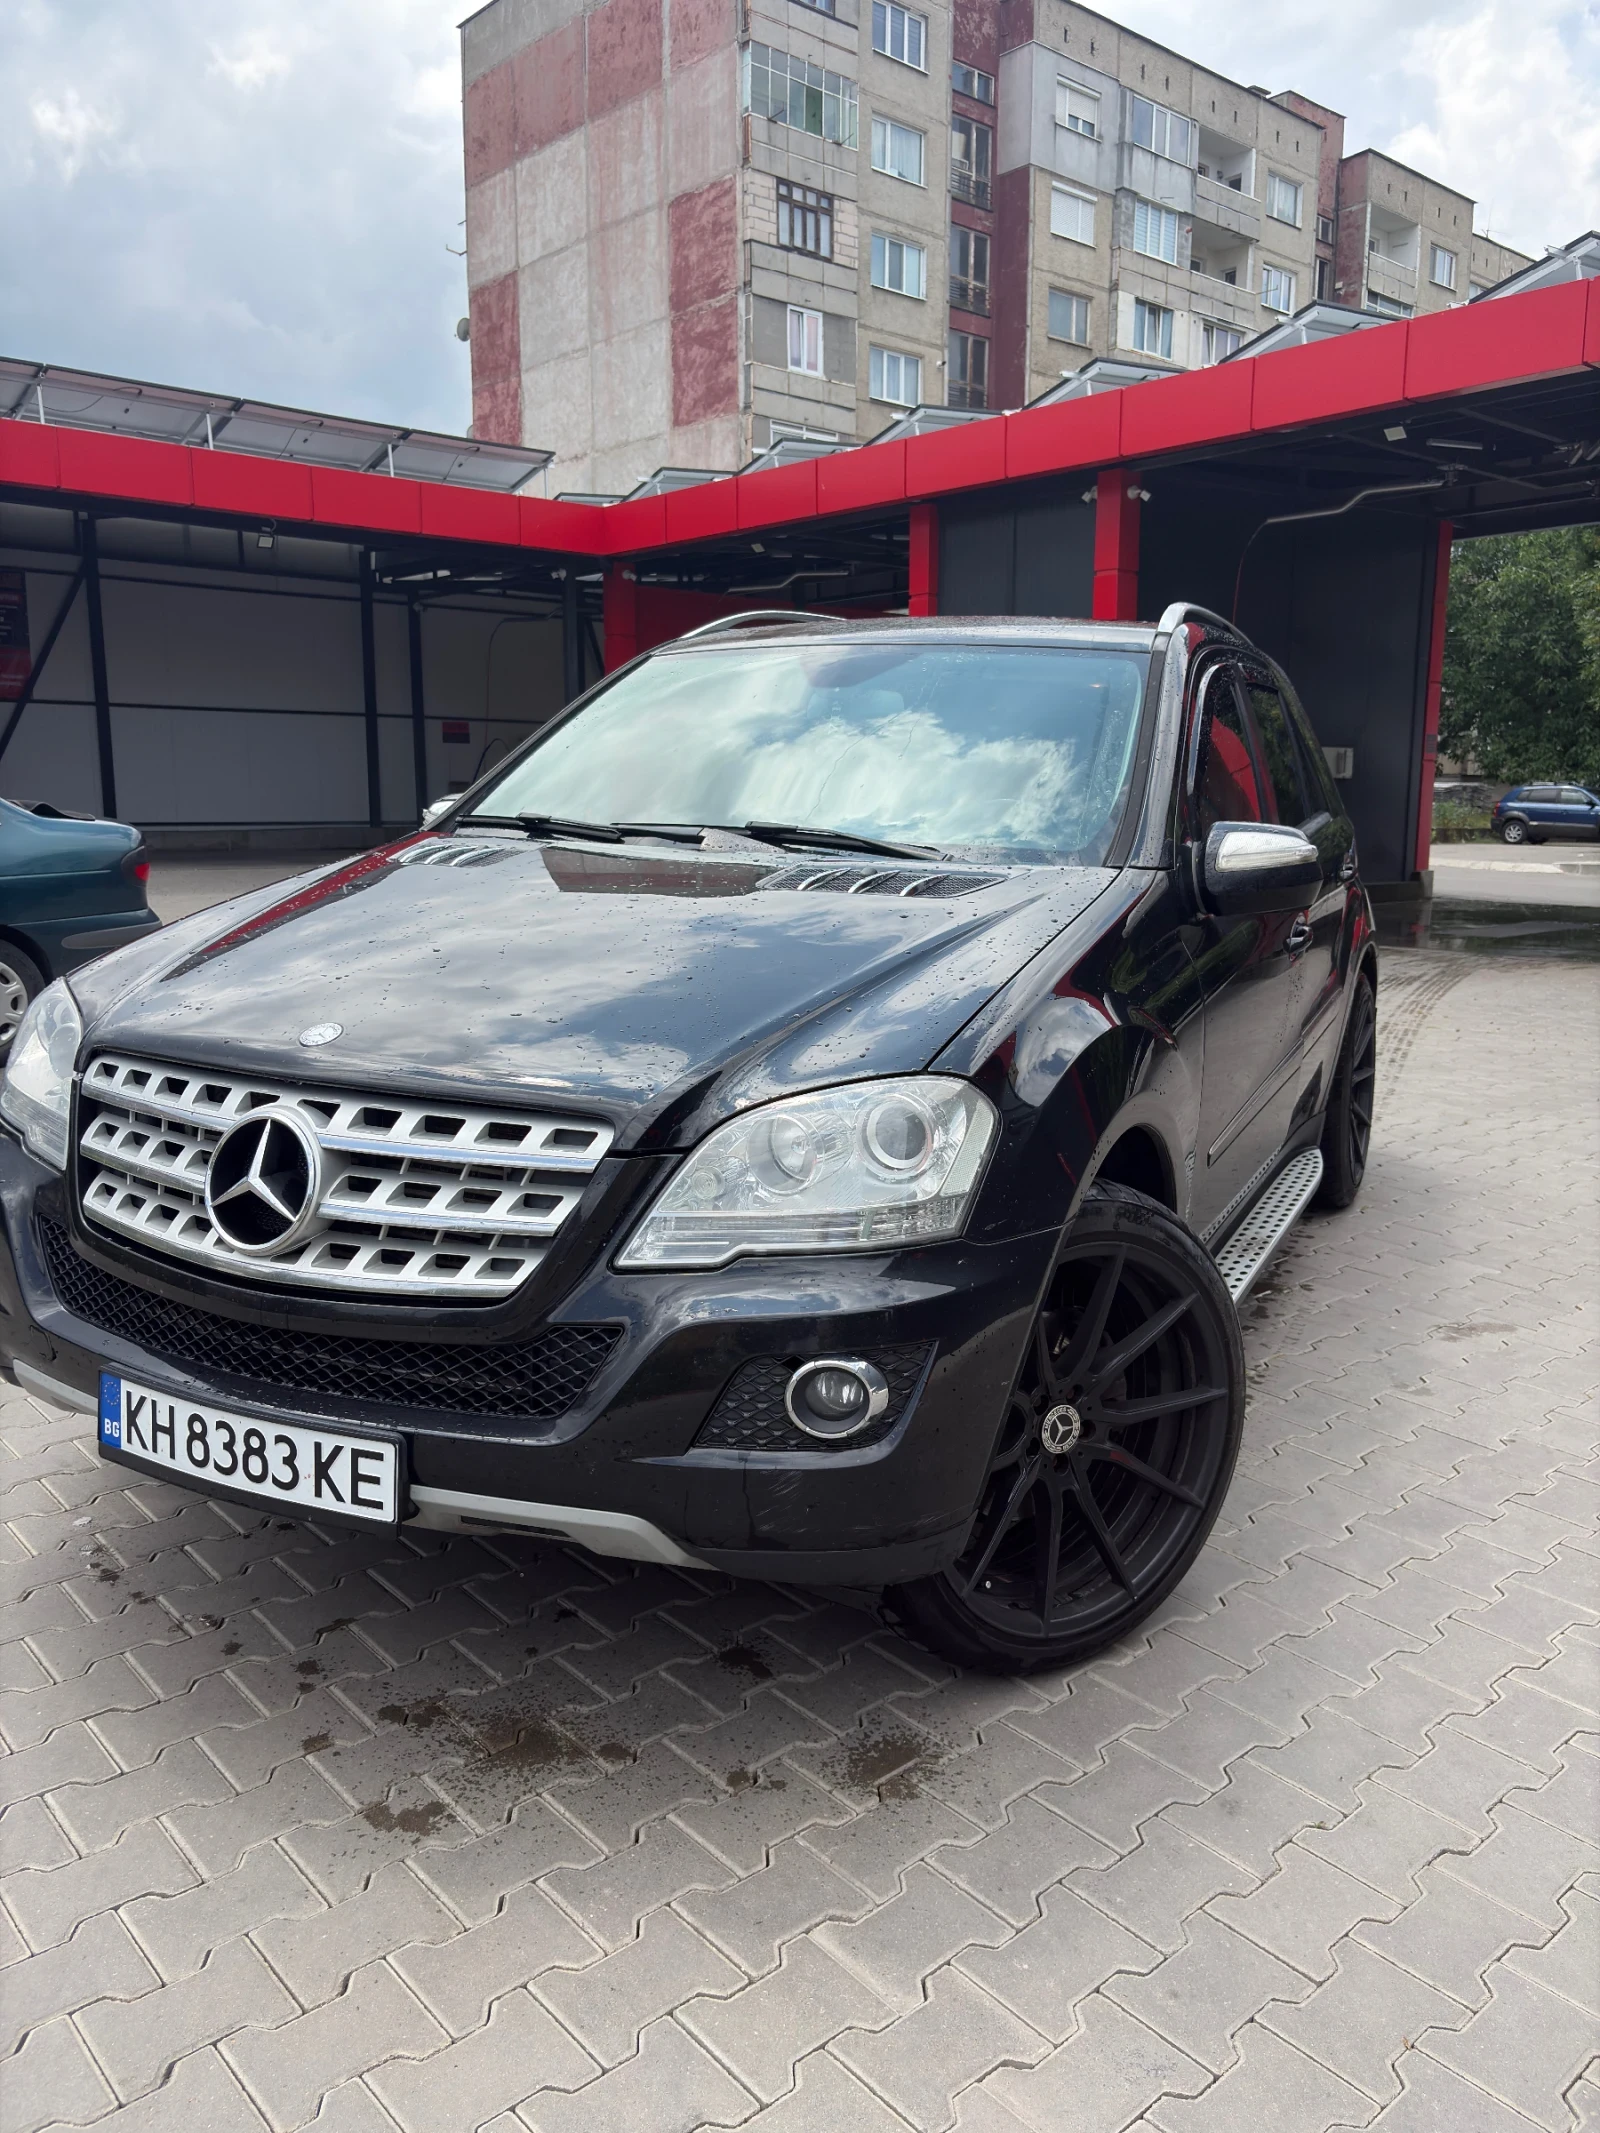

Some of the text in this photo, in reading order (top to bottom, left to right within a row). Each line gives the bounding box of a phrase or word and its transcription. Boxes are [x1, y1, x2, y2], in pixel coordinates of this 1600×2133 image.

[104, 1418, 120, 1436] BG
[126, 1391, 384, 1510] KH 8383 KE
